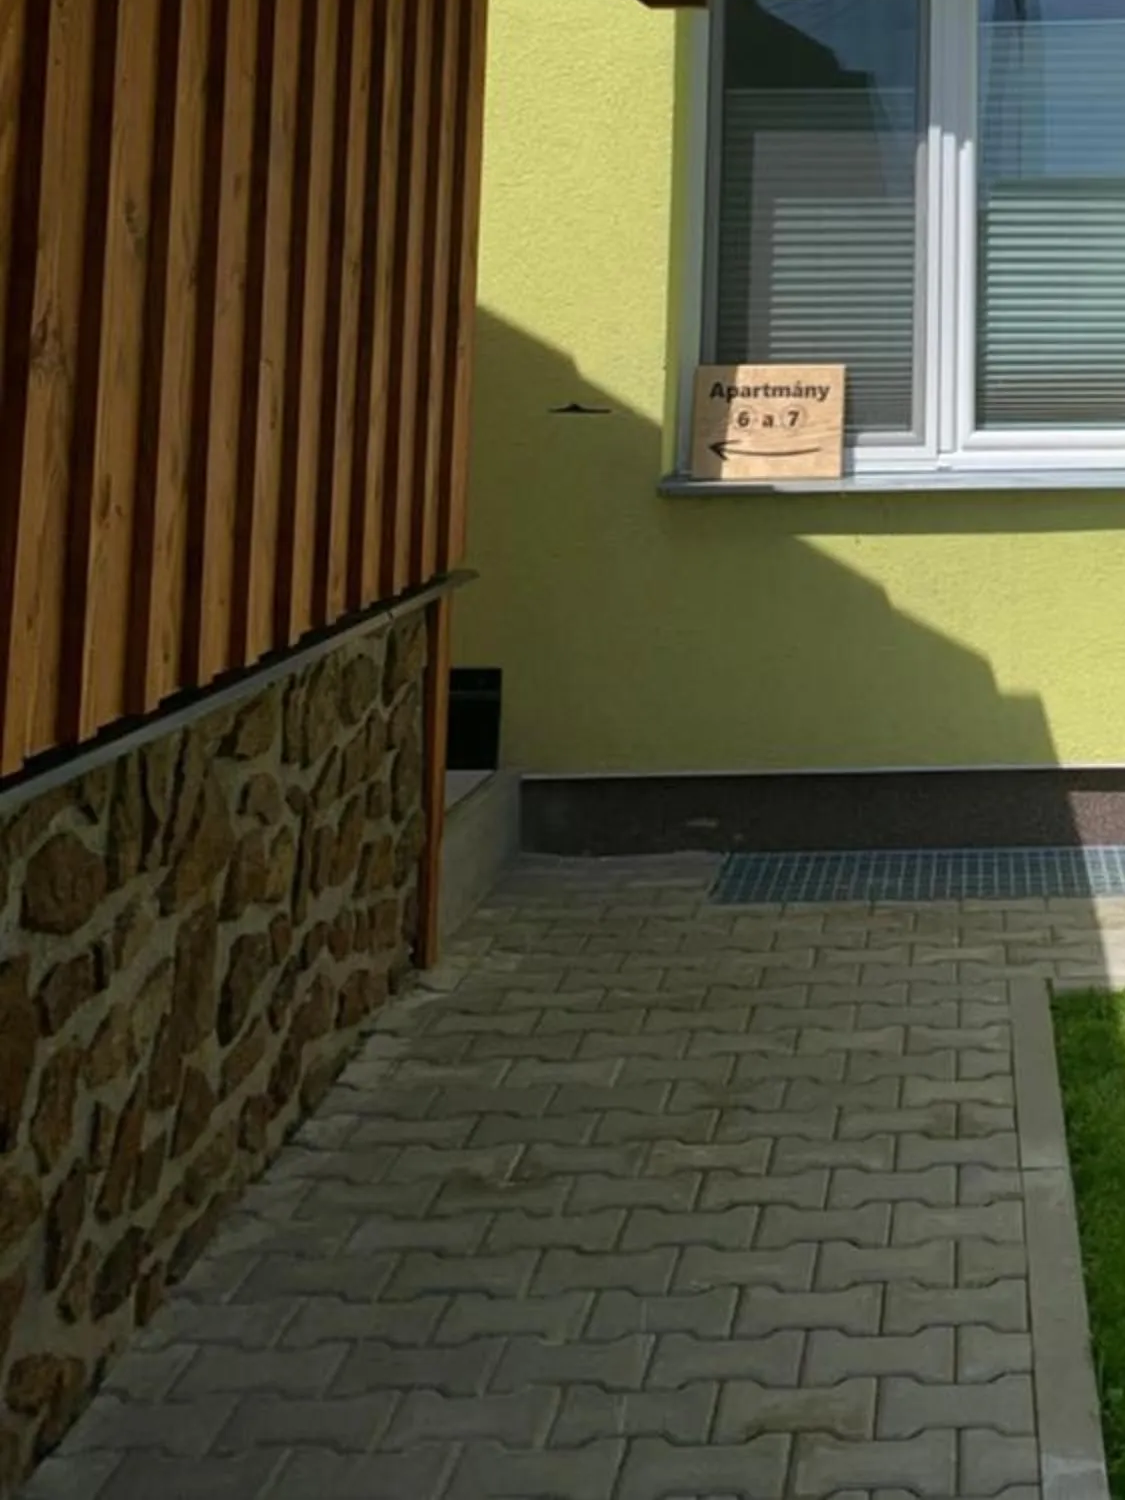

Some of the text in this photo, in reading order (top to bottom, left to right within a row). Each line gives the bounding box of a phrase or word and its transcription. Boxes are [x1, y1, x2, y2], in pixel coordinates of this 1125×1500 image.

[709, 380, 831, 403] Apartmány
[737, 410, 800, 429] 6 a 7
